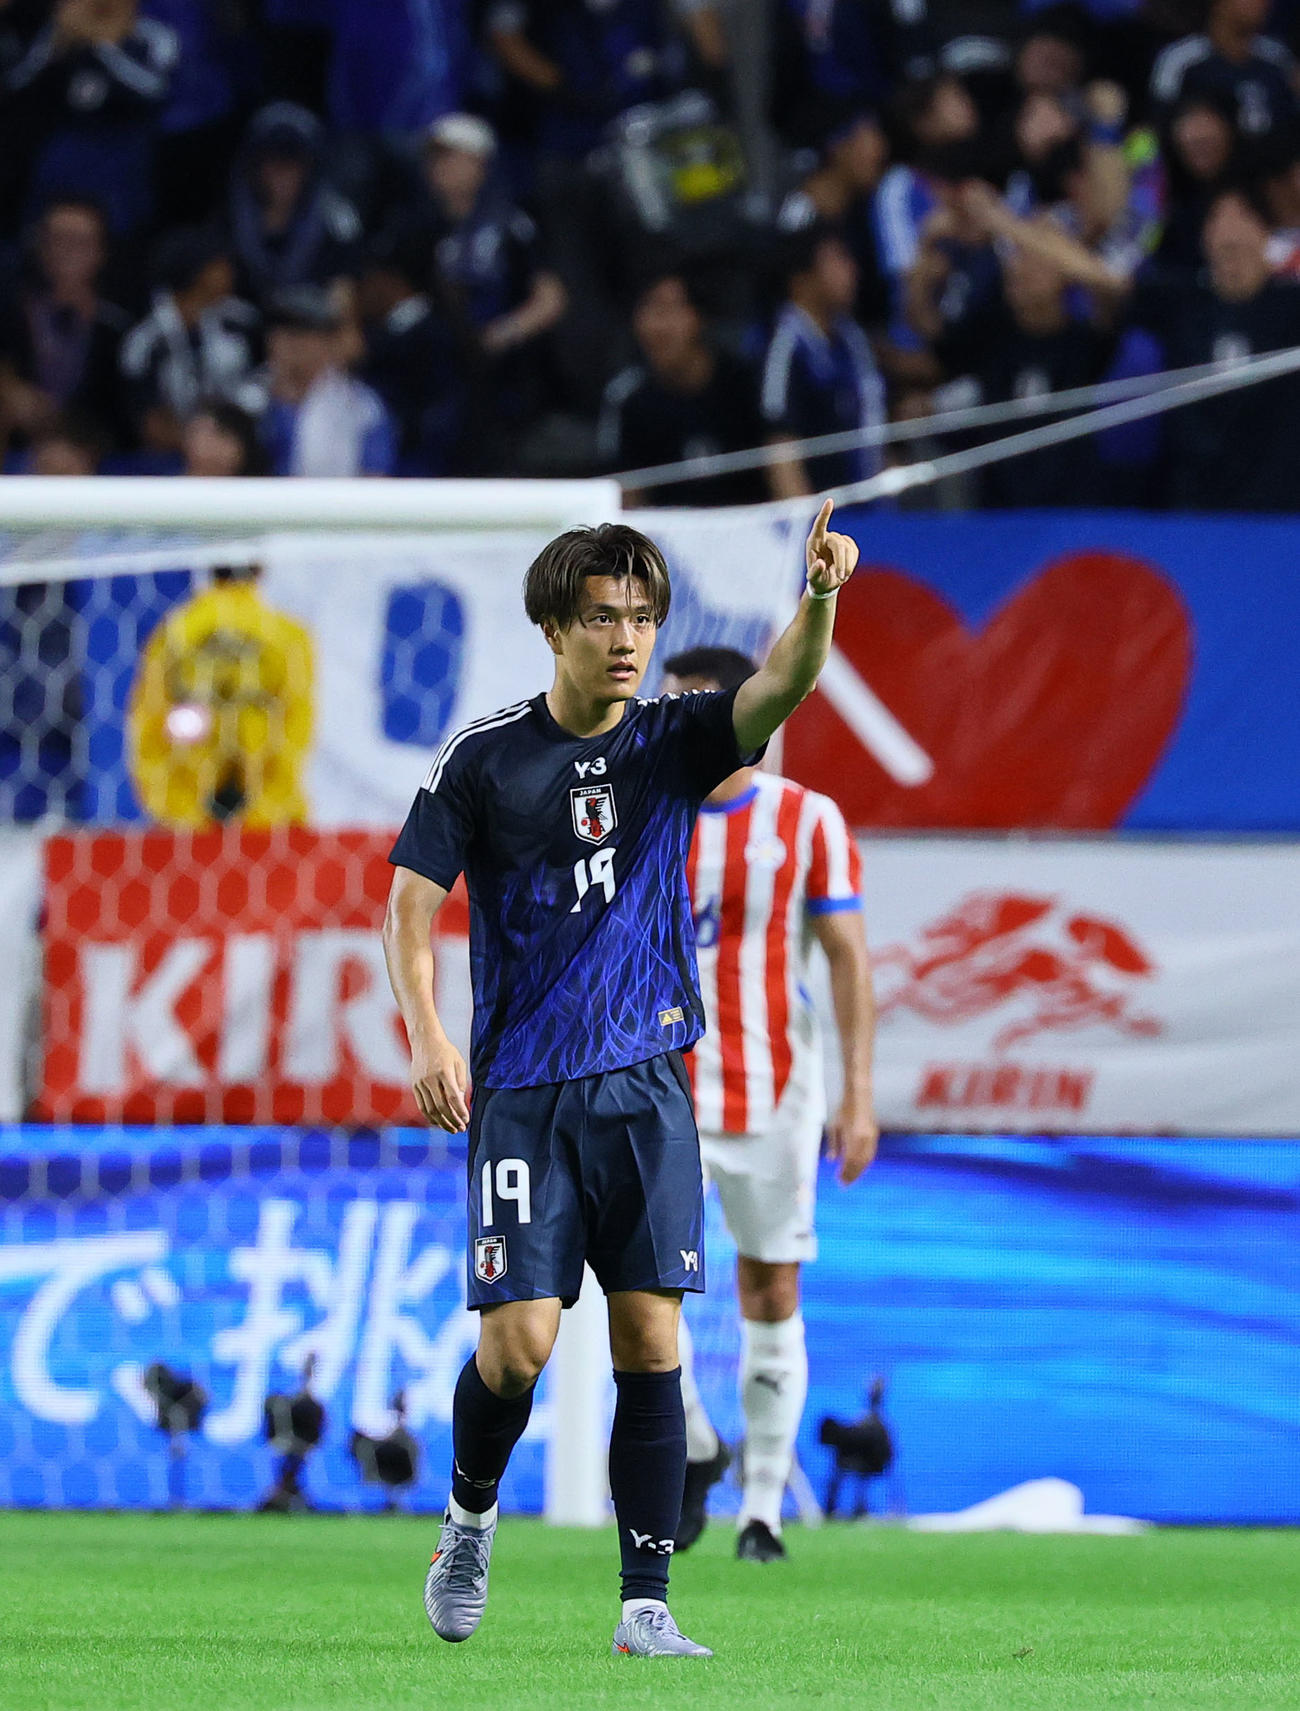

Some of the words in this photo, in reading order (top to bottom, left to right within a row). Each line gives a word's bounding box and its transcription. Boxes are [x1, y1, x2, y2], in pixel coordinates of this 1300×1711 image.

[579, 787, 602, 796] JAPAN
[570, 847, 616, 913] 19
[482, 1158, 531, 1227] 19
[630, 1528, 675, 1554] Y-3
